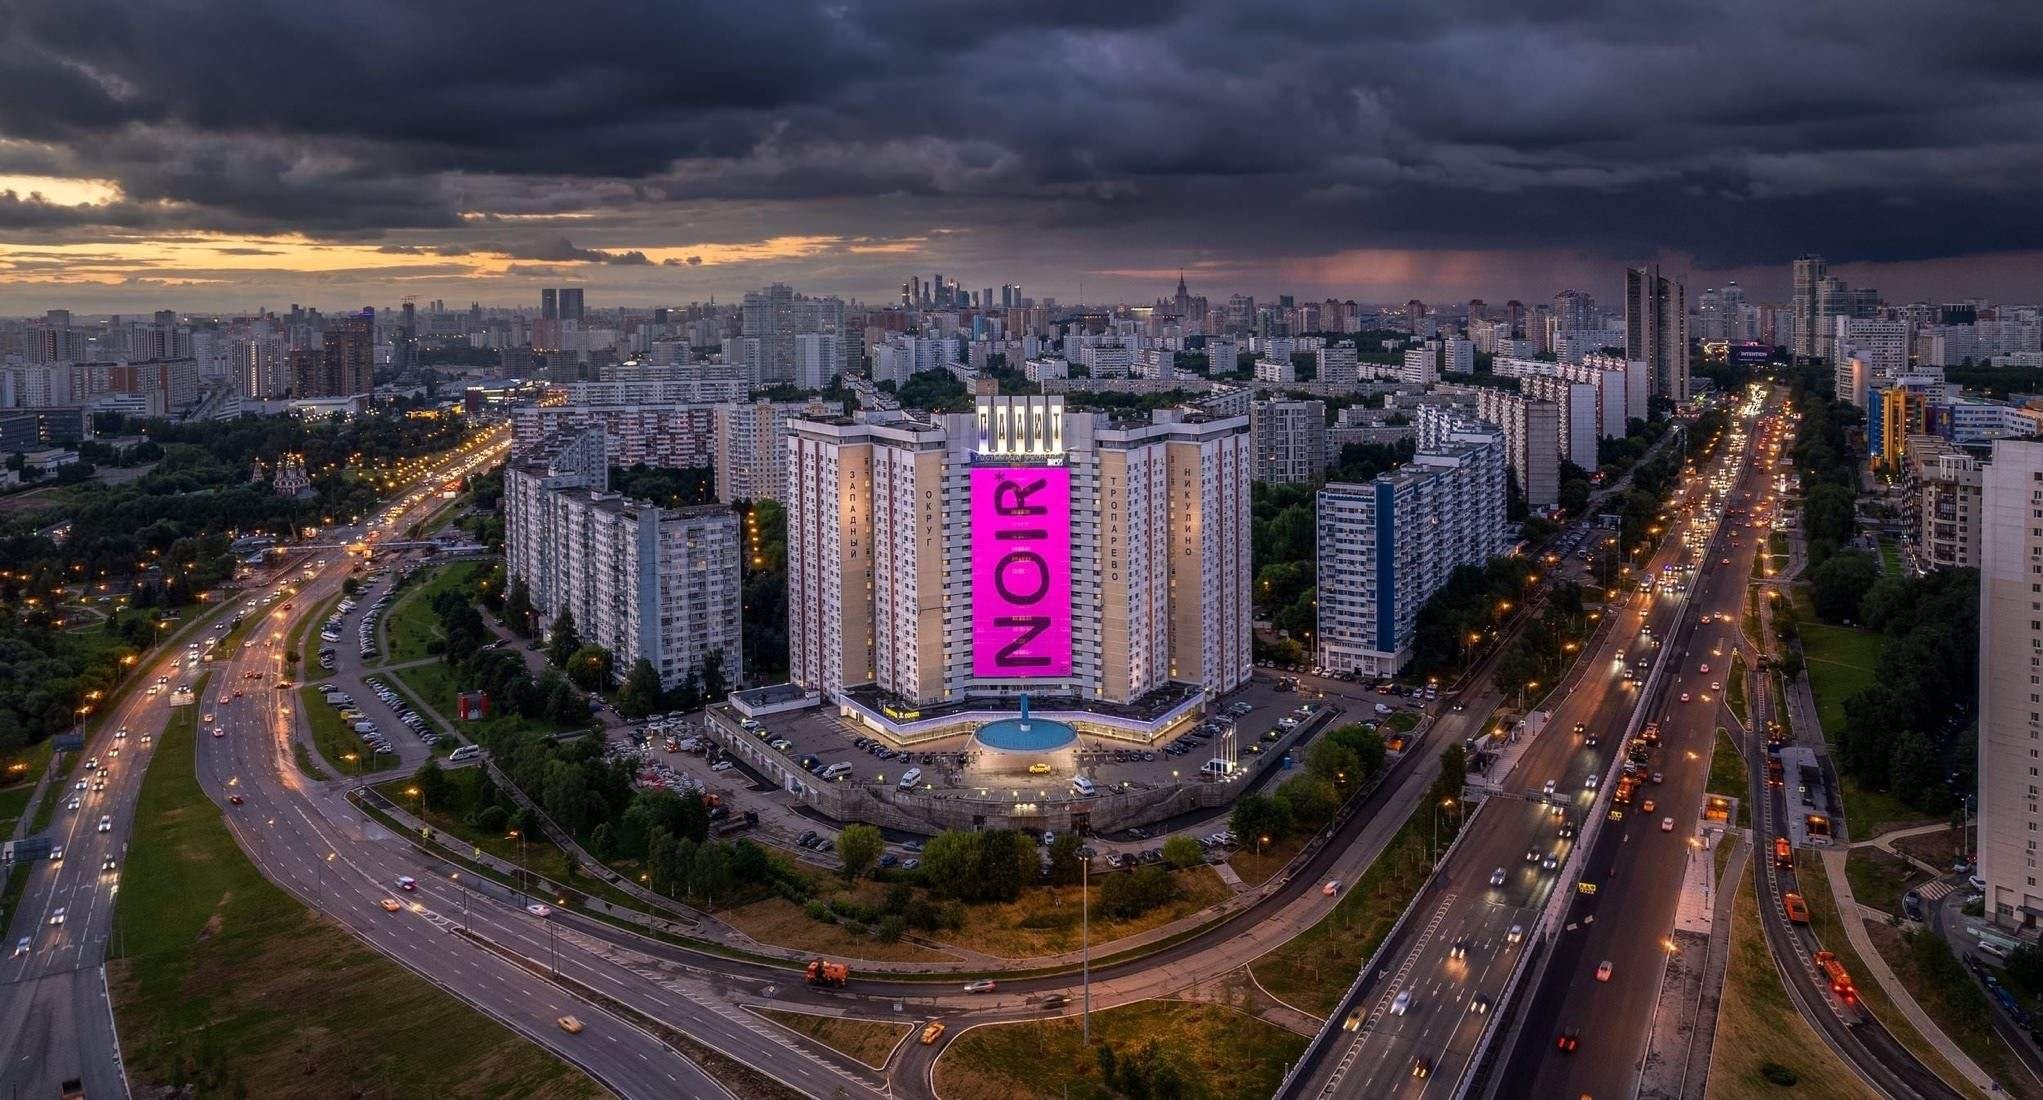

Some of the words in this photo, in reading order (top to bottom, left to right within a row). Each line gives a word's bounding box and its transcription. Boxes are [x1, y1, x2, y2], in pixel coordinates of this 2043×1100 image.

[848, 471, 858, 558] ЗАПАДНЫЙ
[925, 490, 933, 546] ОКРУГ
[1110, 477, 1119, 581] ТРОПАРЕВО
[1184, 467, 1193, 556] НИКУЛИНО
